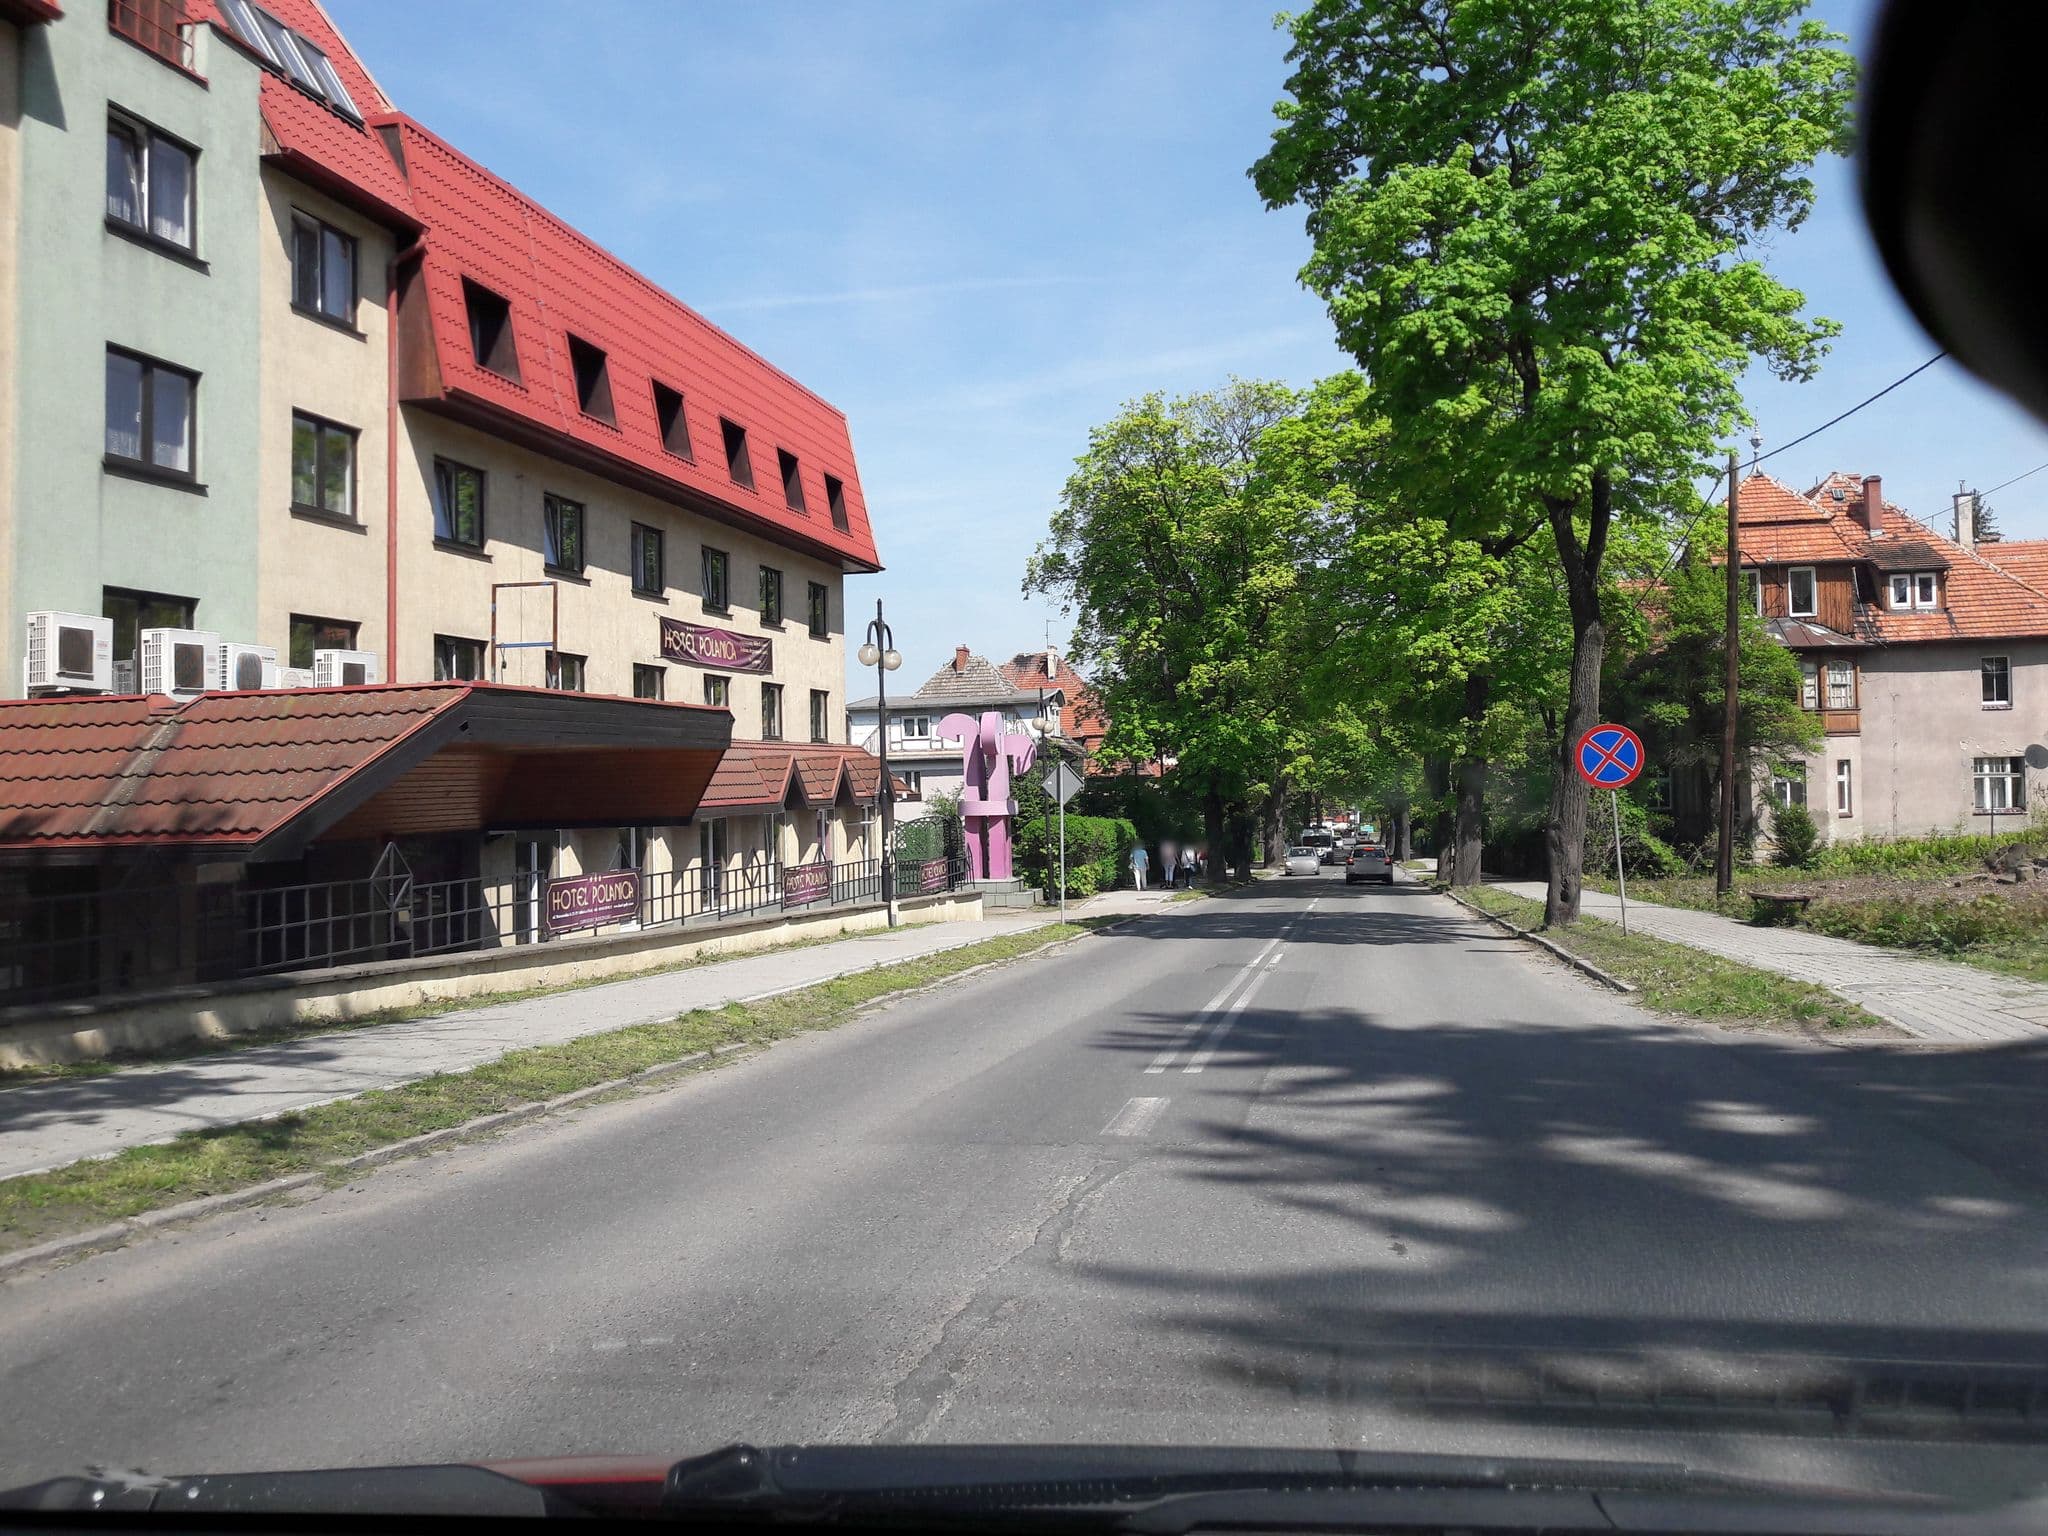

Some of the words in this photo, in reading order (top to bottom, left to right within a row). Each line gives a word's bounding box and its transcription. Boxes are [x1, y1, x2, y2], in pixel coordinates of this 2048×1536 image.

[664, 627, 697, 654] HOTEL
[699, 636, 737, 660] POLANICA
[552, 886, 589, 911] HOTEL
[591, 880, 634, 905] POLANICA
